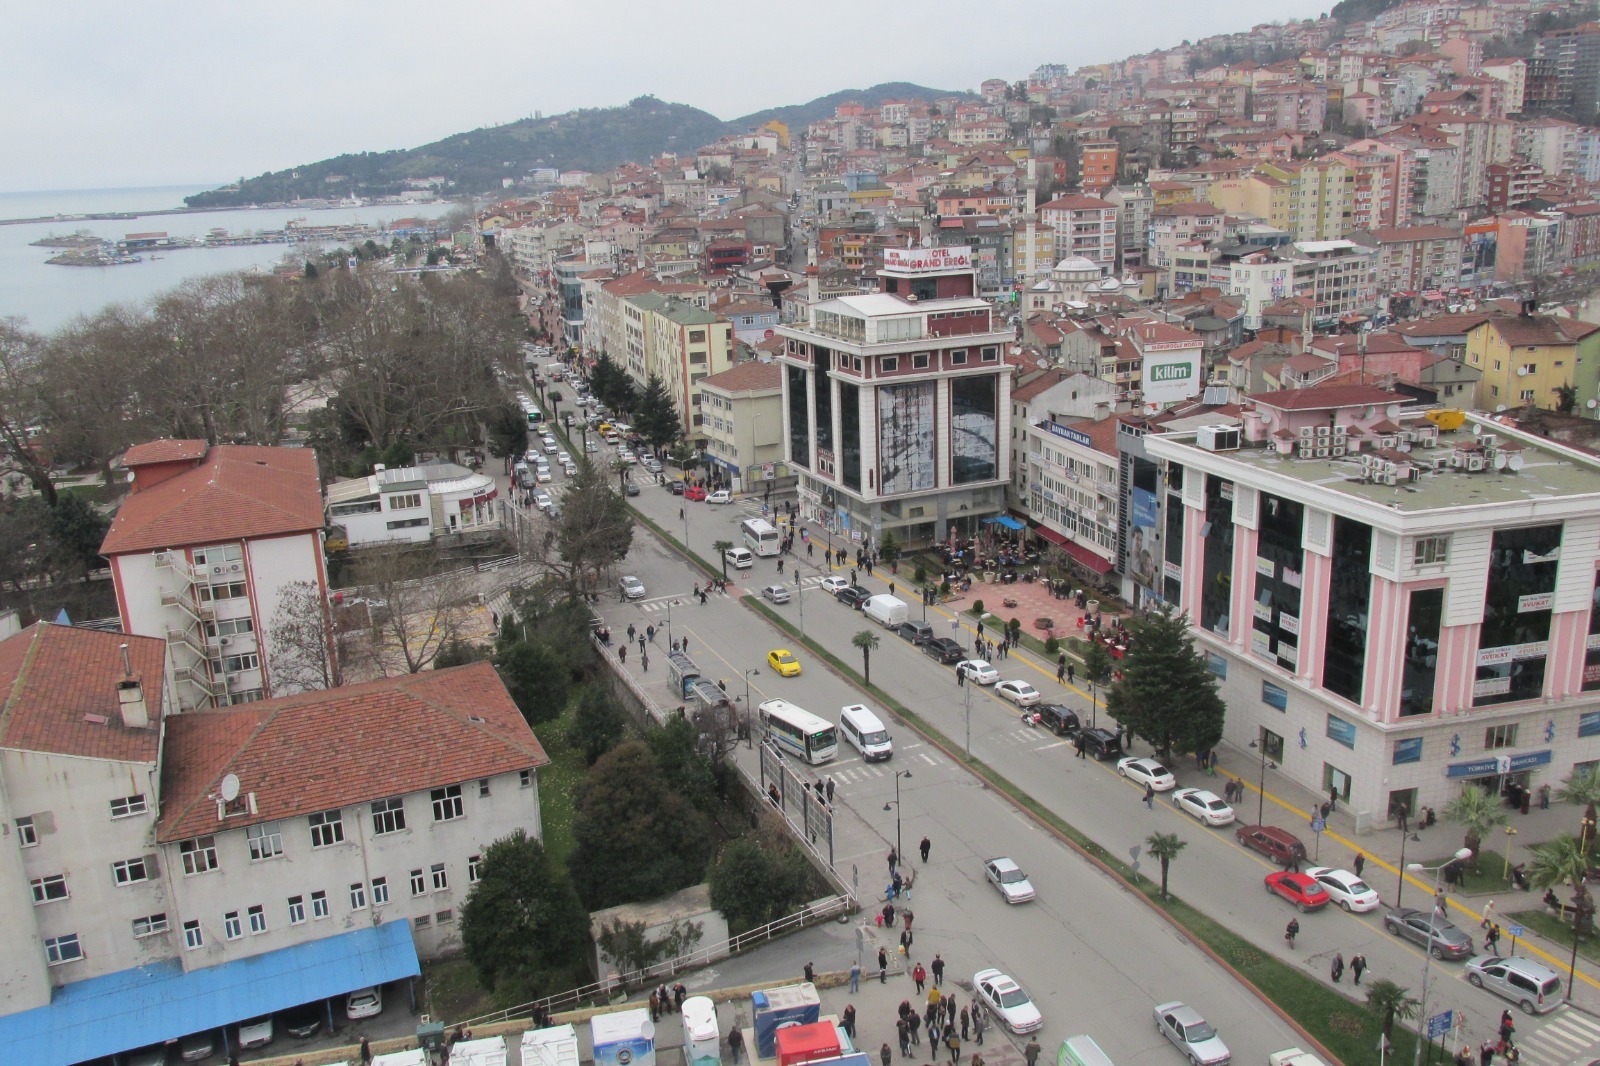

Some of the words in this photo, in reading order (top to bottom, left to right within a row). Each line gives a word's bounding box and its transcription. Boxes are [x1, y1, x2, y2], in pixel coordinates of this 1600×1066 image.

[910, 257, 942, 269] GRAND
[1155, 366, 1187, 379] kilim
[1051, 425, 1090, 445] BAYRAKTARLAR
[1468, 763, 1496, 772] TÜRKİYE
[813, 1046, 838, 1055] AKBANK
